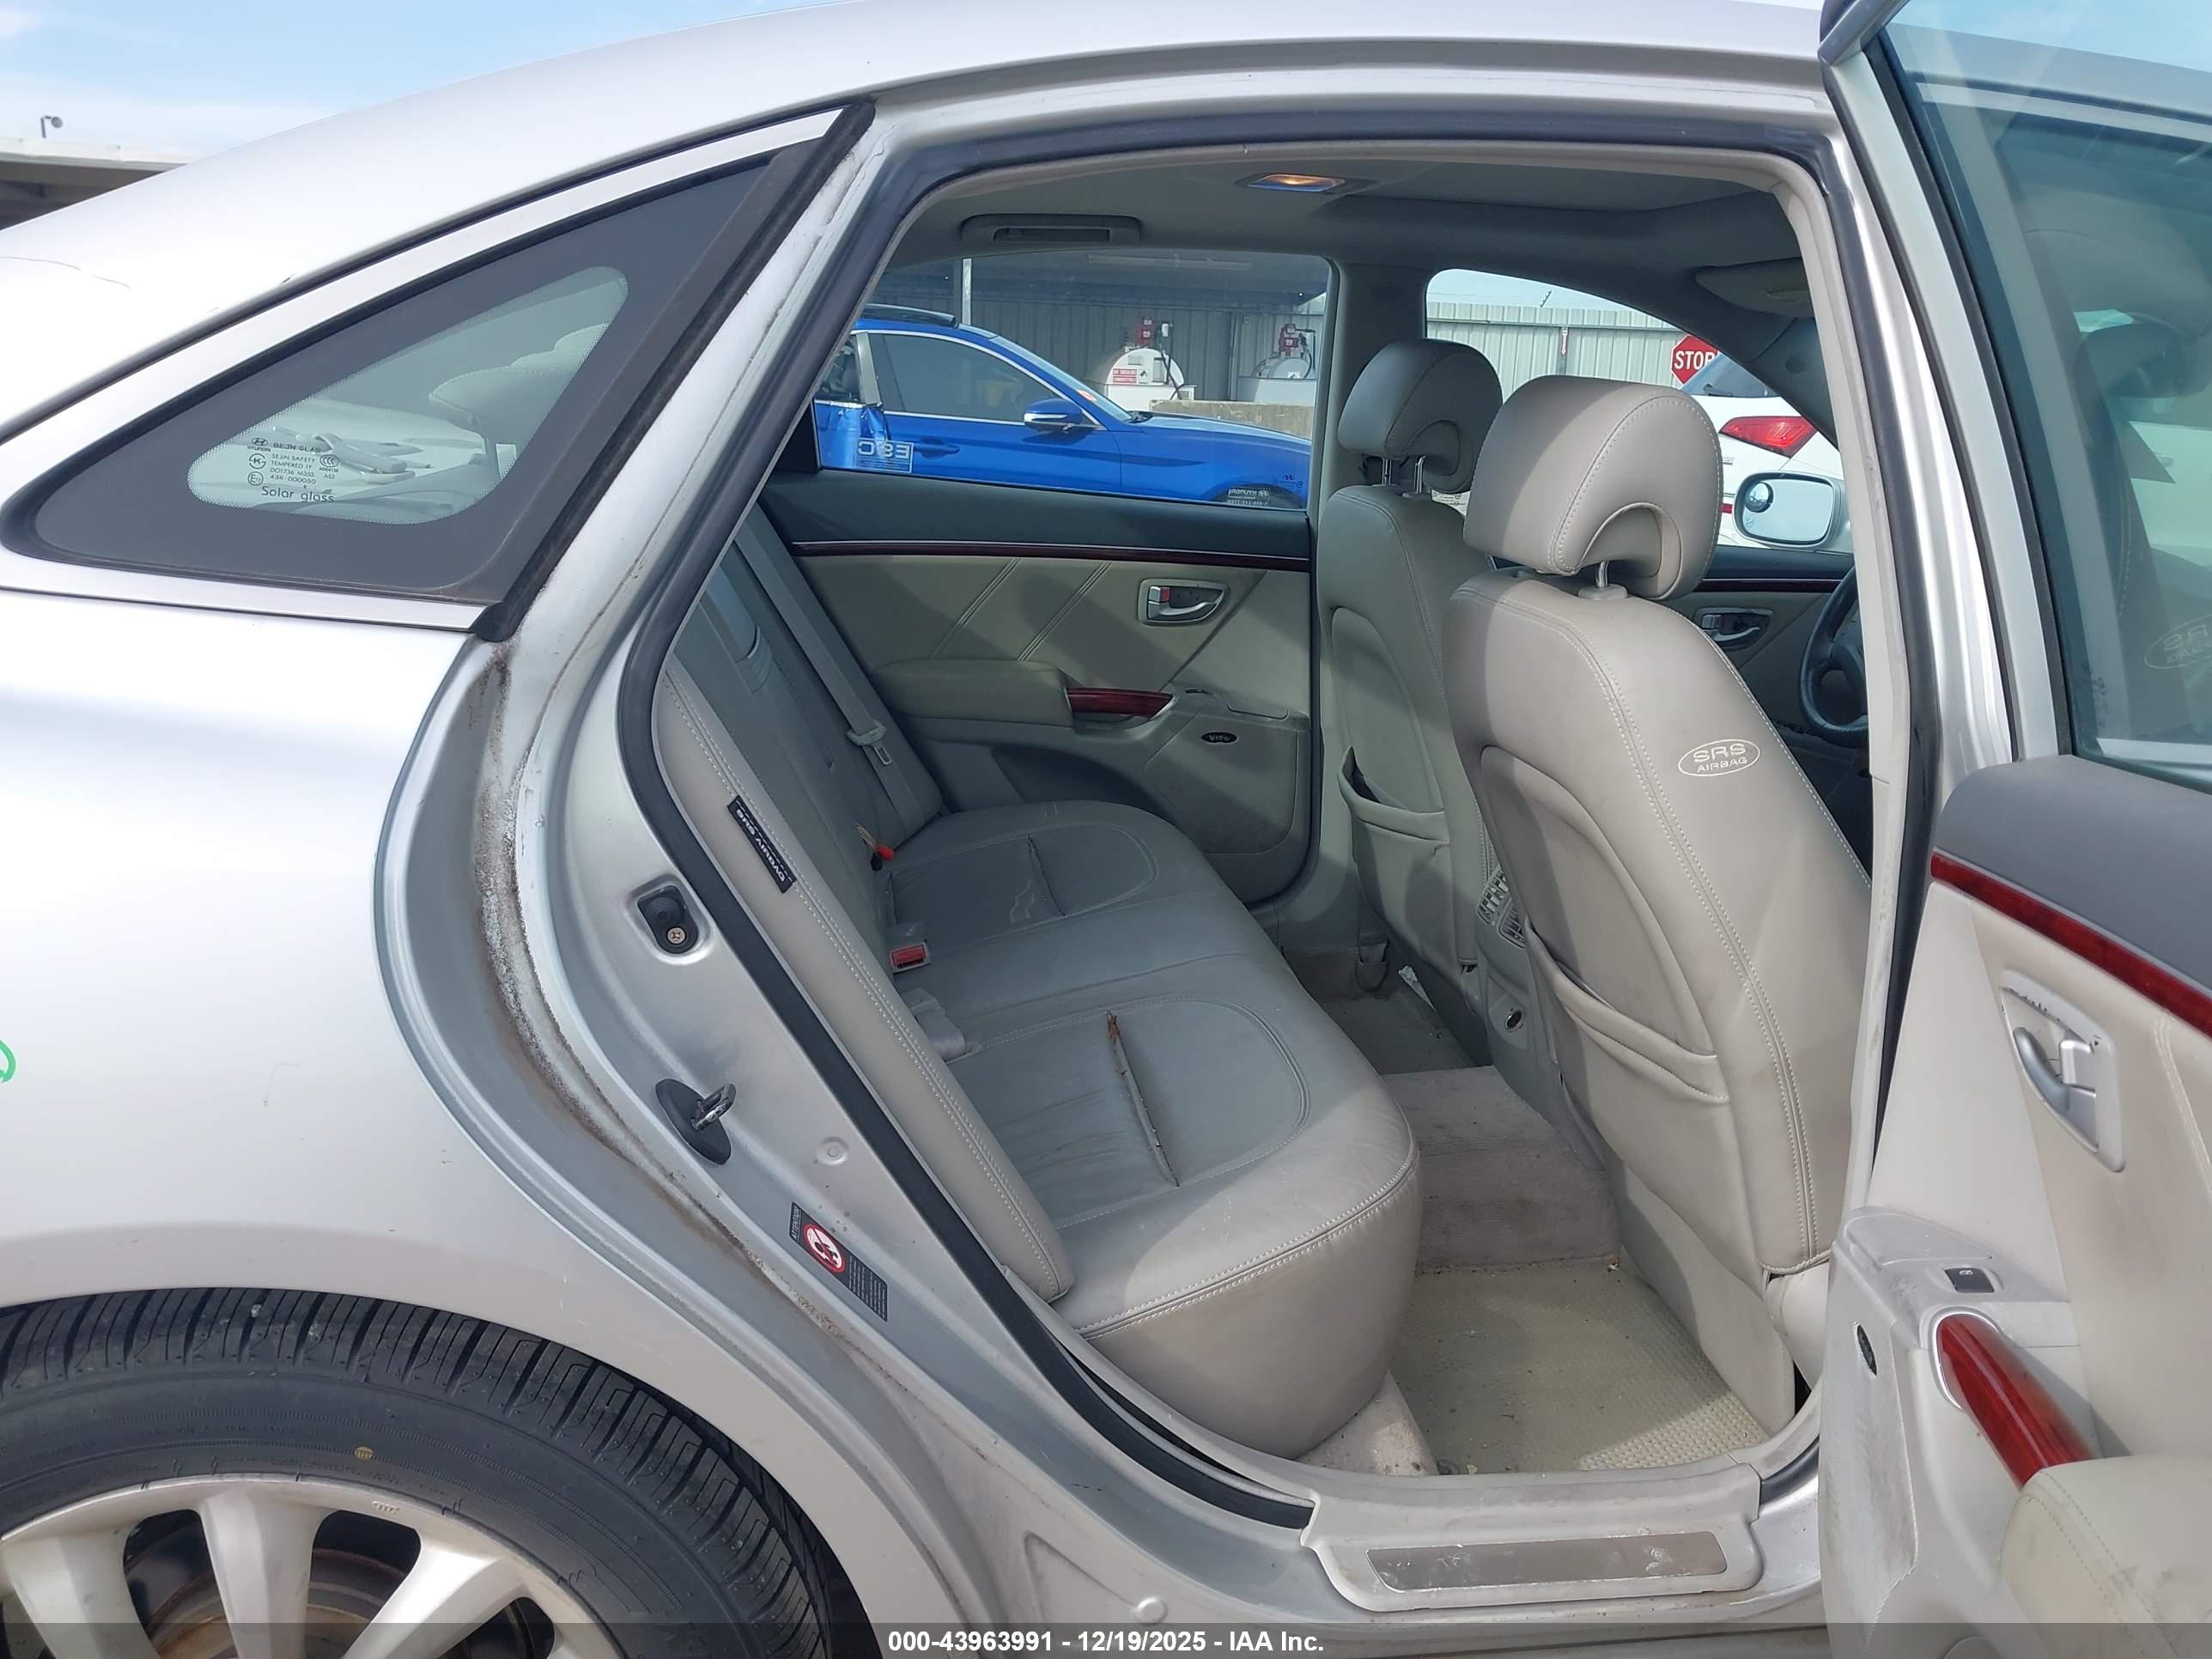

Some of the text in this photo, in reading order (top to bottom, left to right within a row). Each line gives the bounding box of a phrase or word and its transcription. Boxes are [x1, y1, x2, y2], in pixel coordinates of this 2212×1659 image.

[1674, 350, 1716, 370] STOP
[270, 460, 303, 469] TEMPERED
[261, 485, 335, 503] Solar glass
[1692, 743, 1747, 763] SRS
[1697, 757, 1747, 773] AIRBAG
[736, 808, 786, 883] SRS AIRBAG
